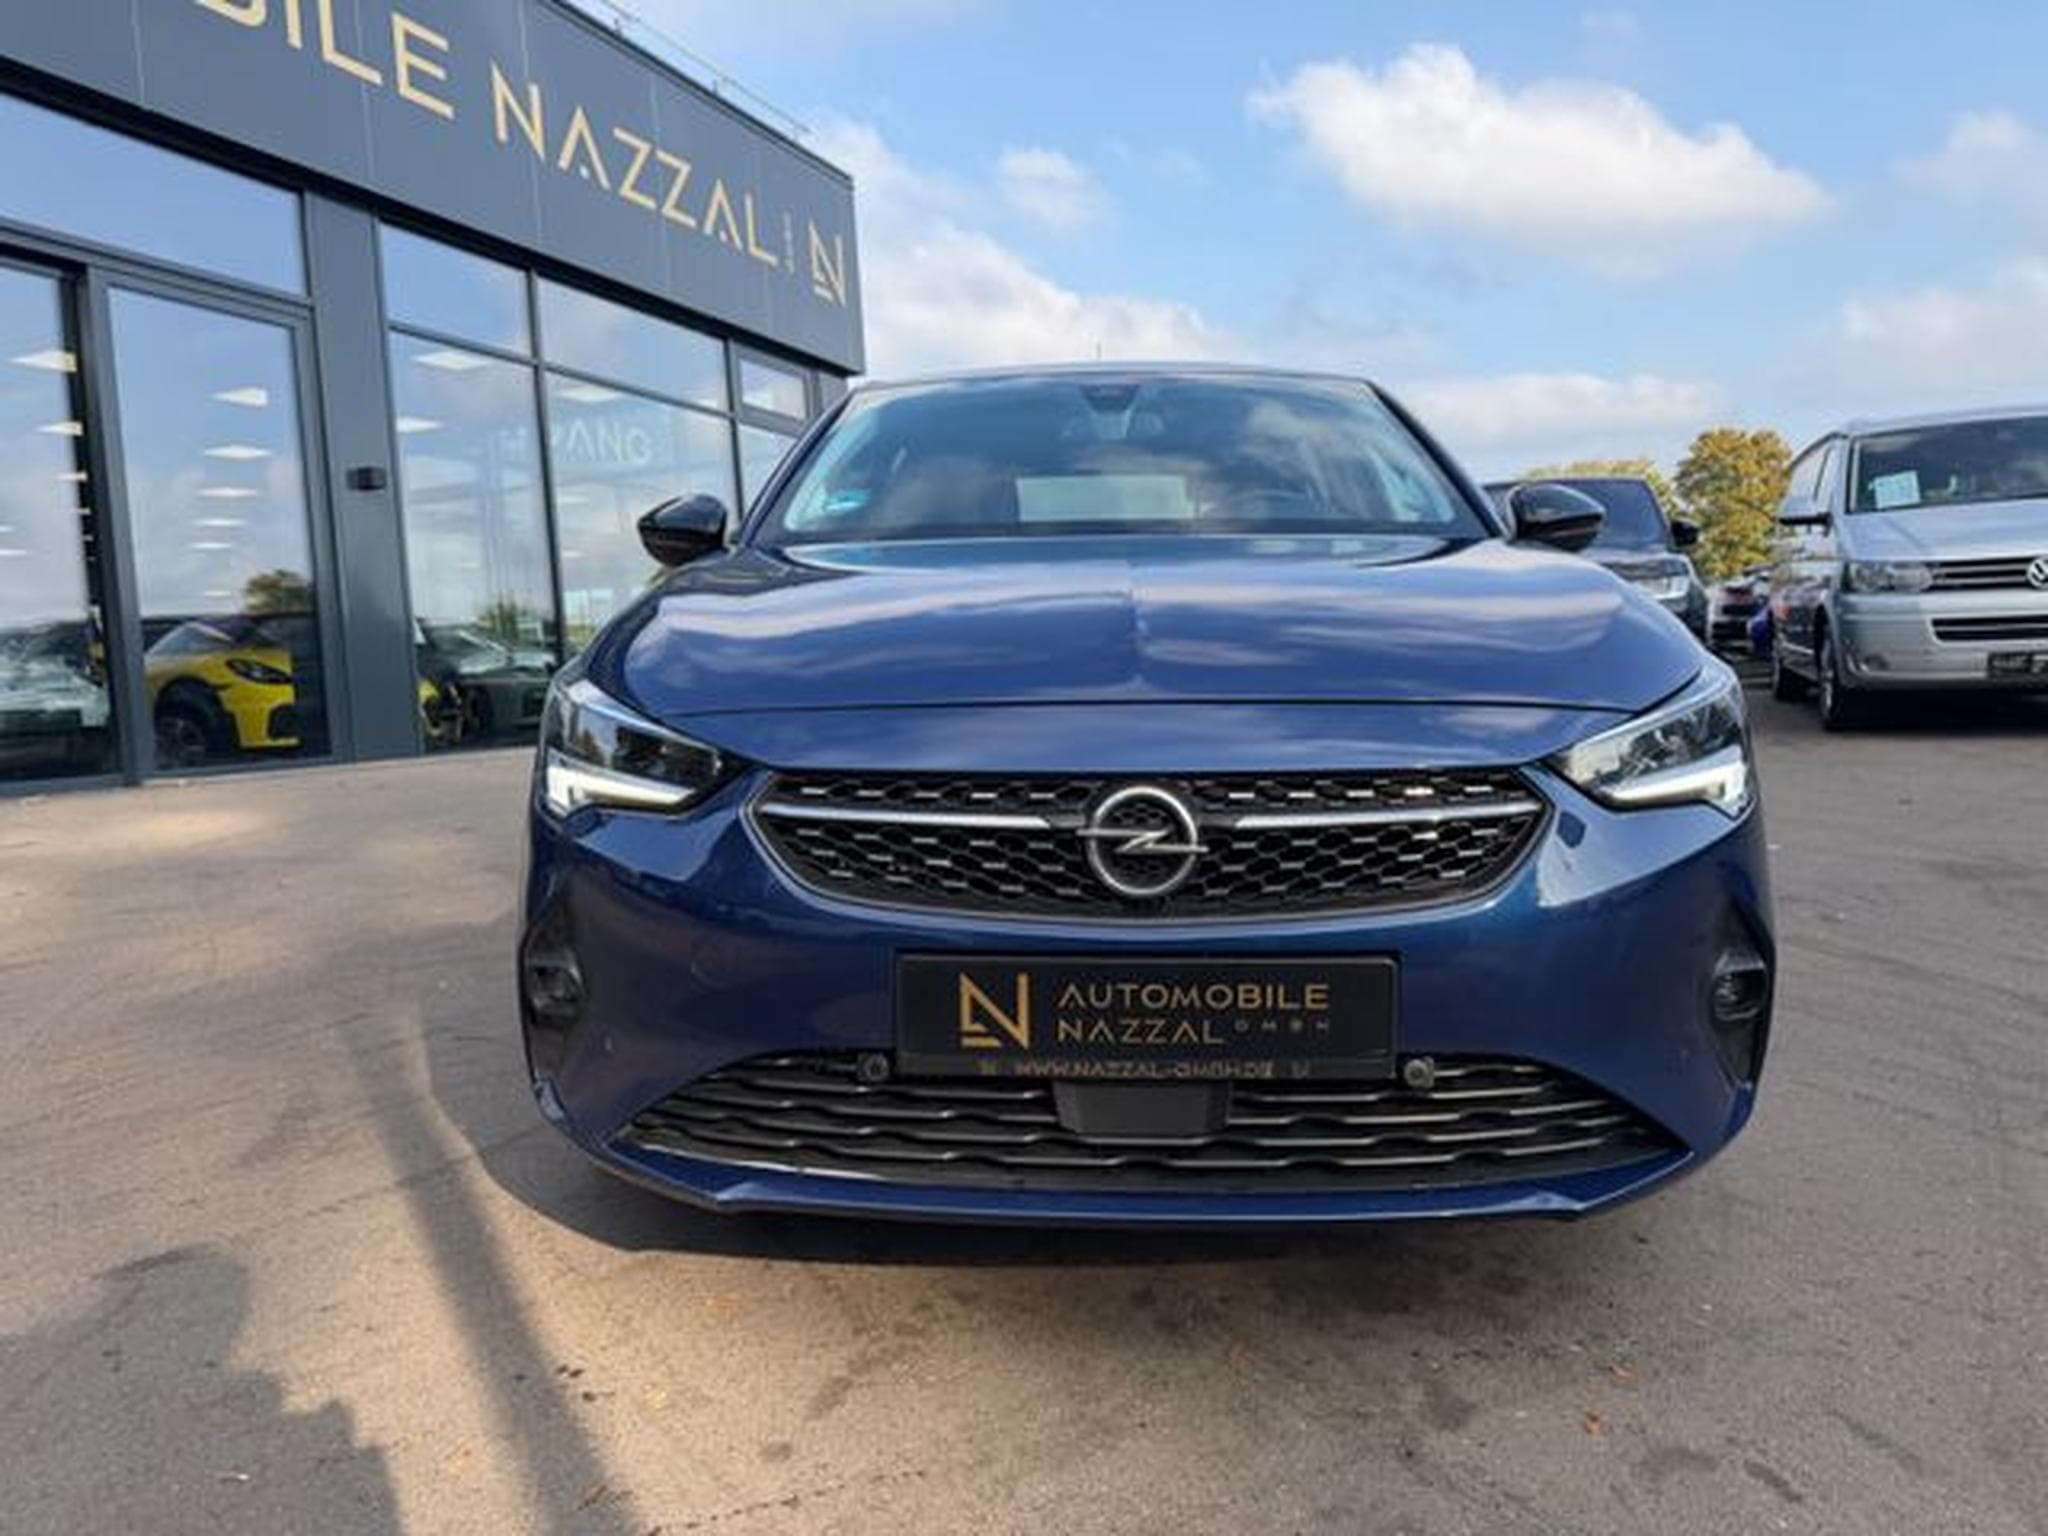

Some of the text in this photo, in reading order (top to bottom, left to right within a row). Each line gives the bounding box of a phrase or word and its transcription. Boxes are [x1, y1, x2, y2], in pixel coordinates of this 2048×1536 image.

[491, 60, 779, 267] NAZZAL
[1058, 983, 1330, 1010] AUTOMOBILE
[1057, 1018, 1226, 1046] NAZZAL
